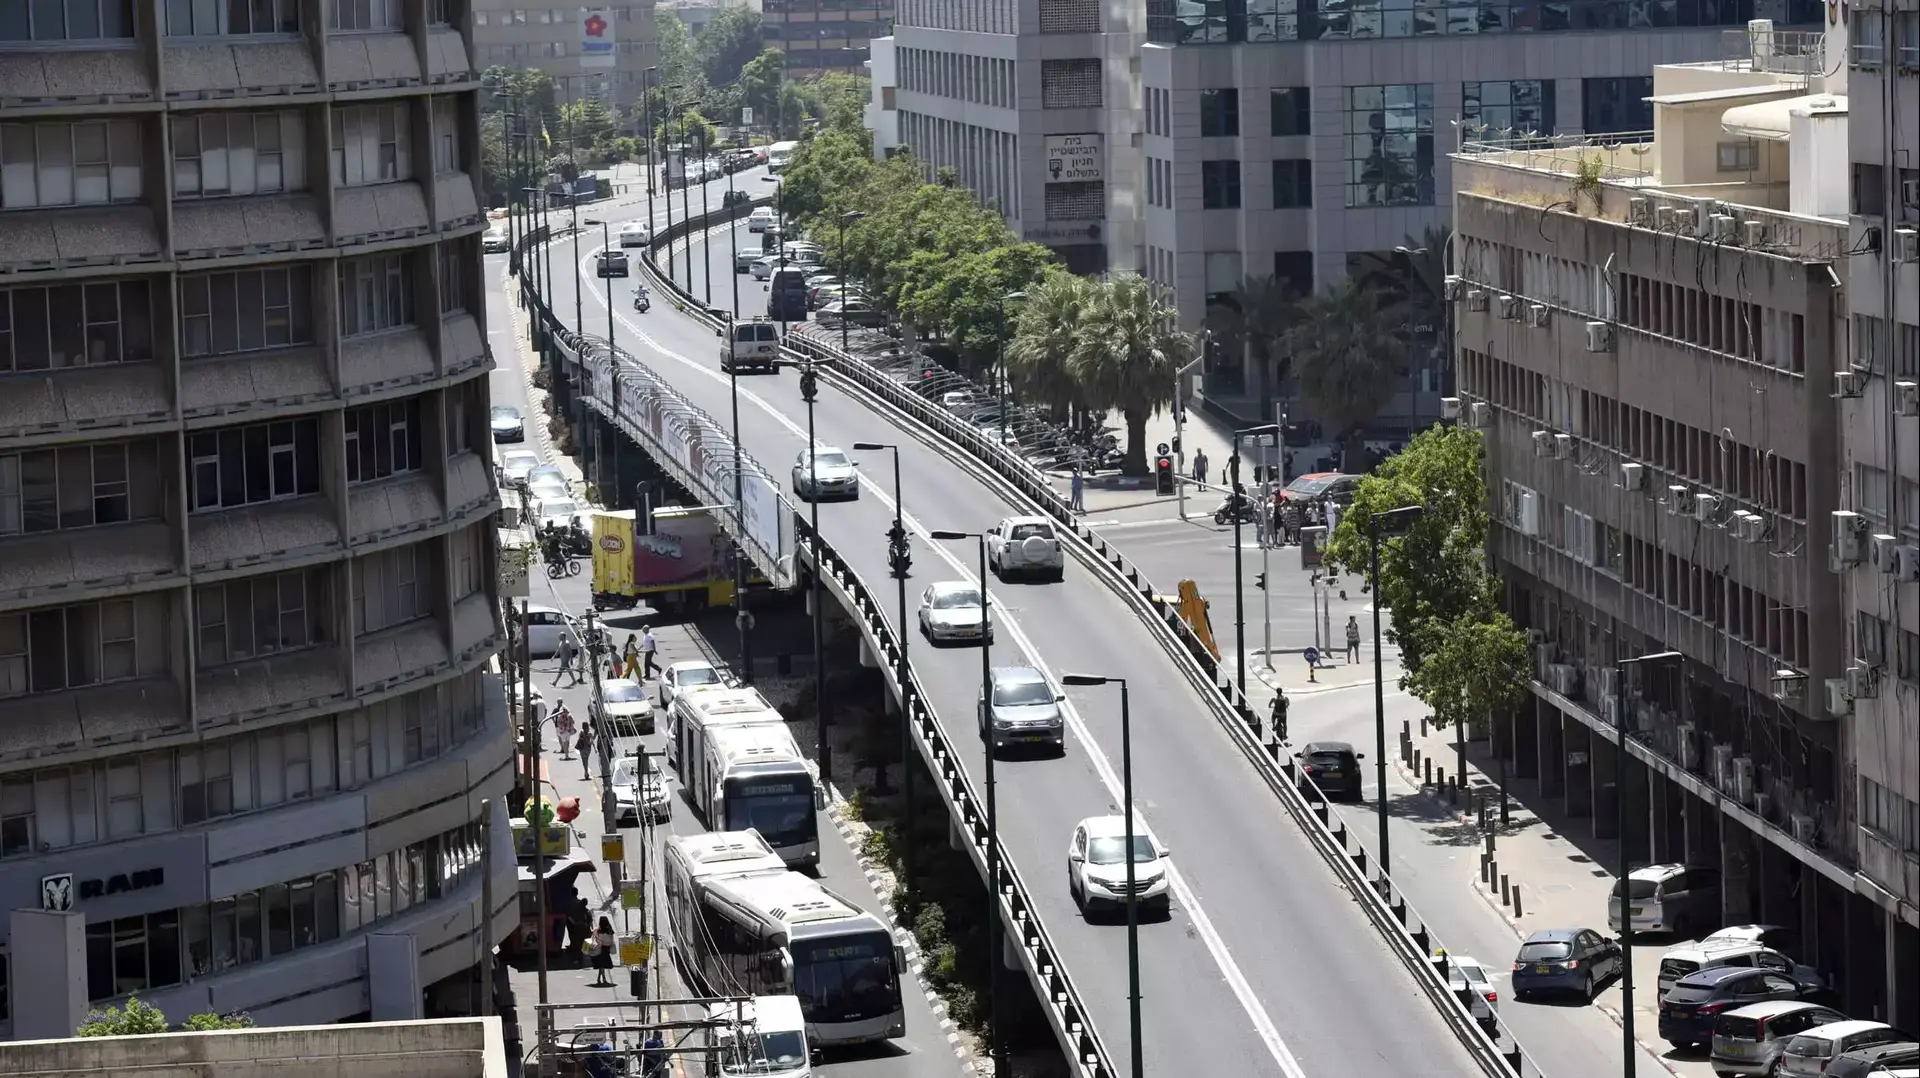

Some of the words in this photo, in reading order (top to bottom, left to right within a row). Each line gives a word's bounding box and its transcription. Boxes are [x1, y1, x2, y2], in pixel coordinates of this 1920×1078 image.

[1064, 137, 1082, 145] בית
[1050, 145, 1098, 157] רובינשטיין
[1071, 157, 1094, 168] חניון
[1066, 168, 1100, 178] בתשלום
[80, 867, 164, 899] RAM
